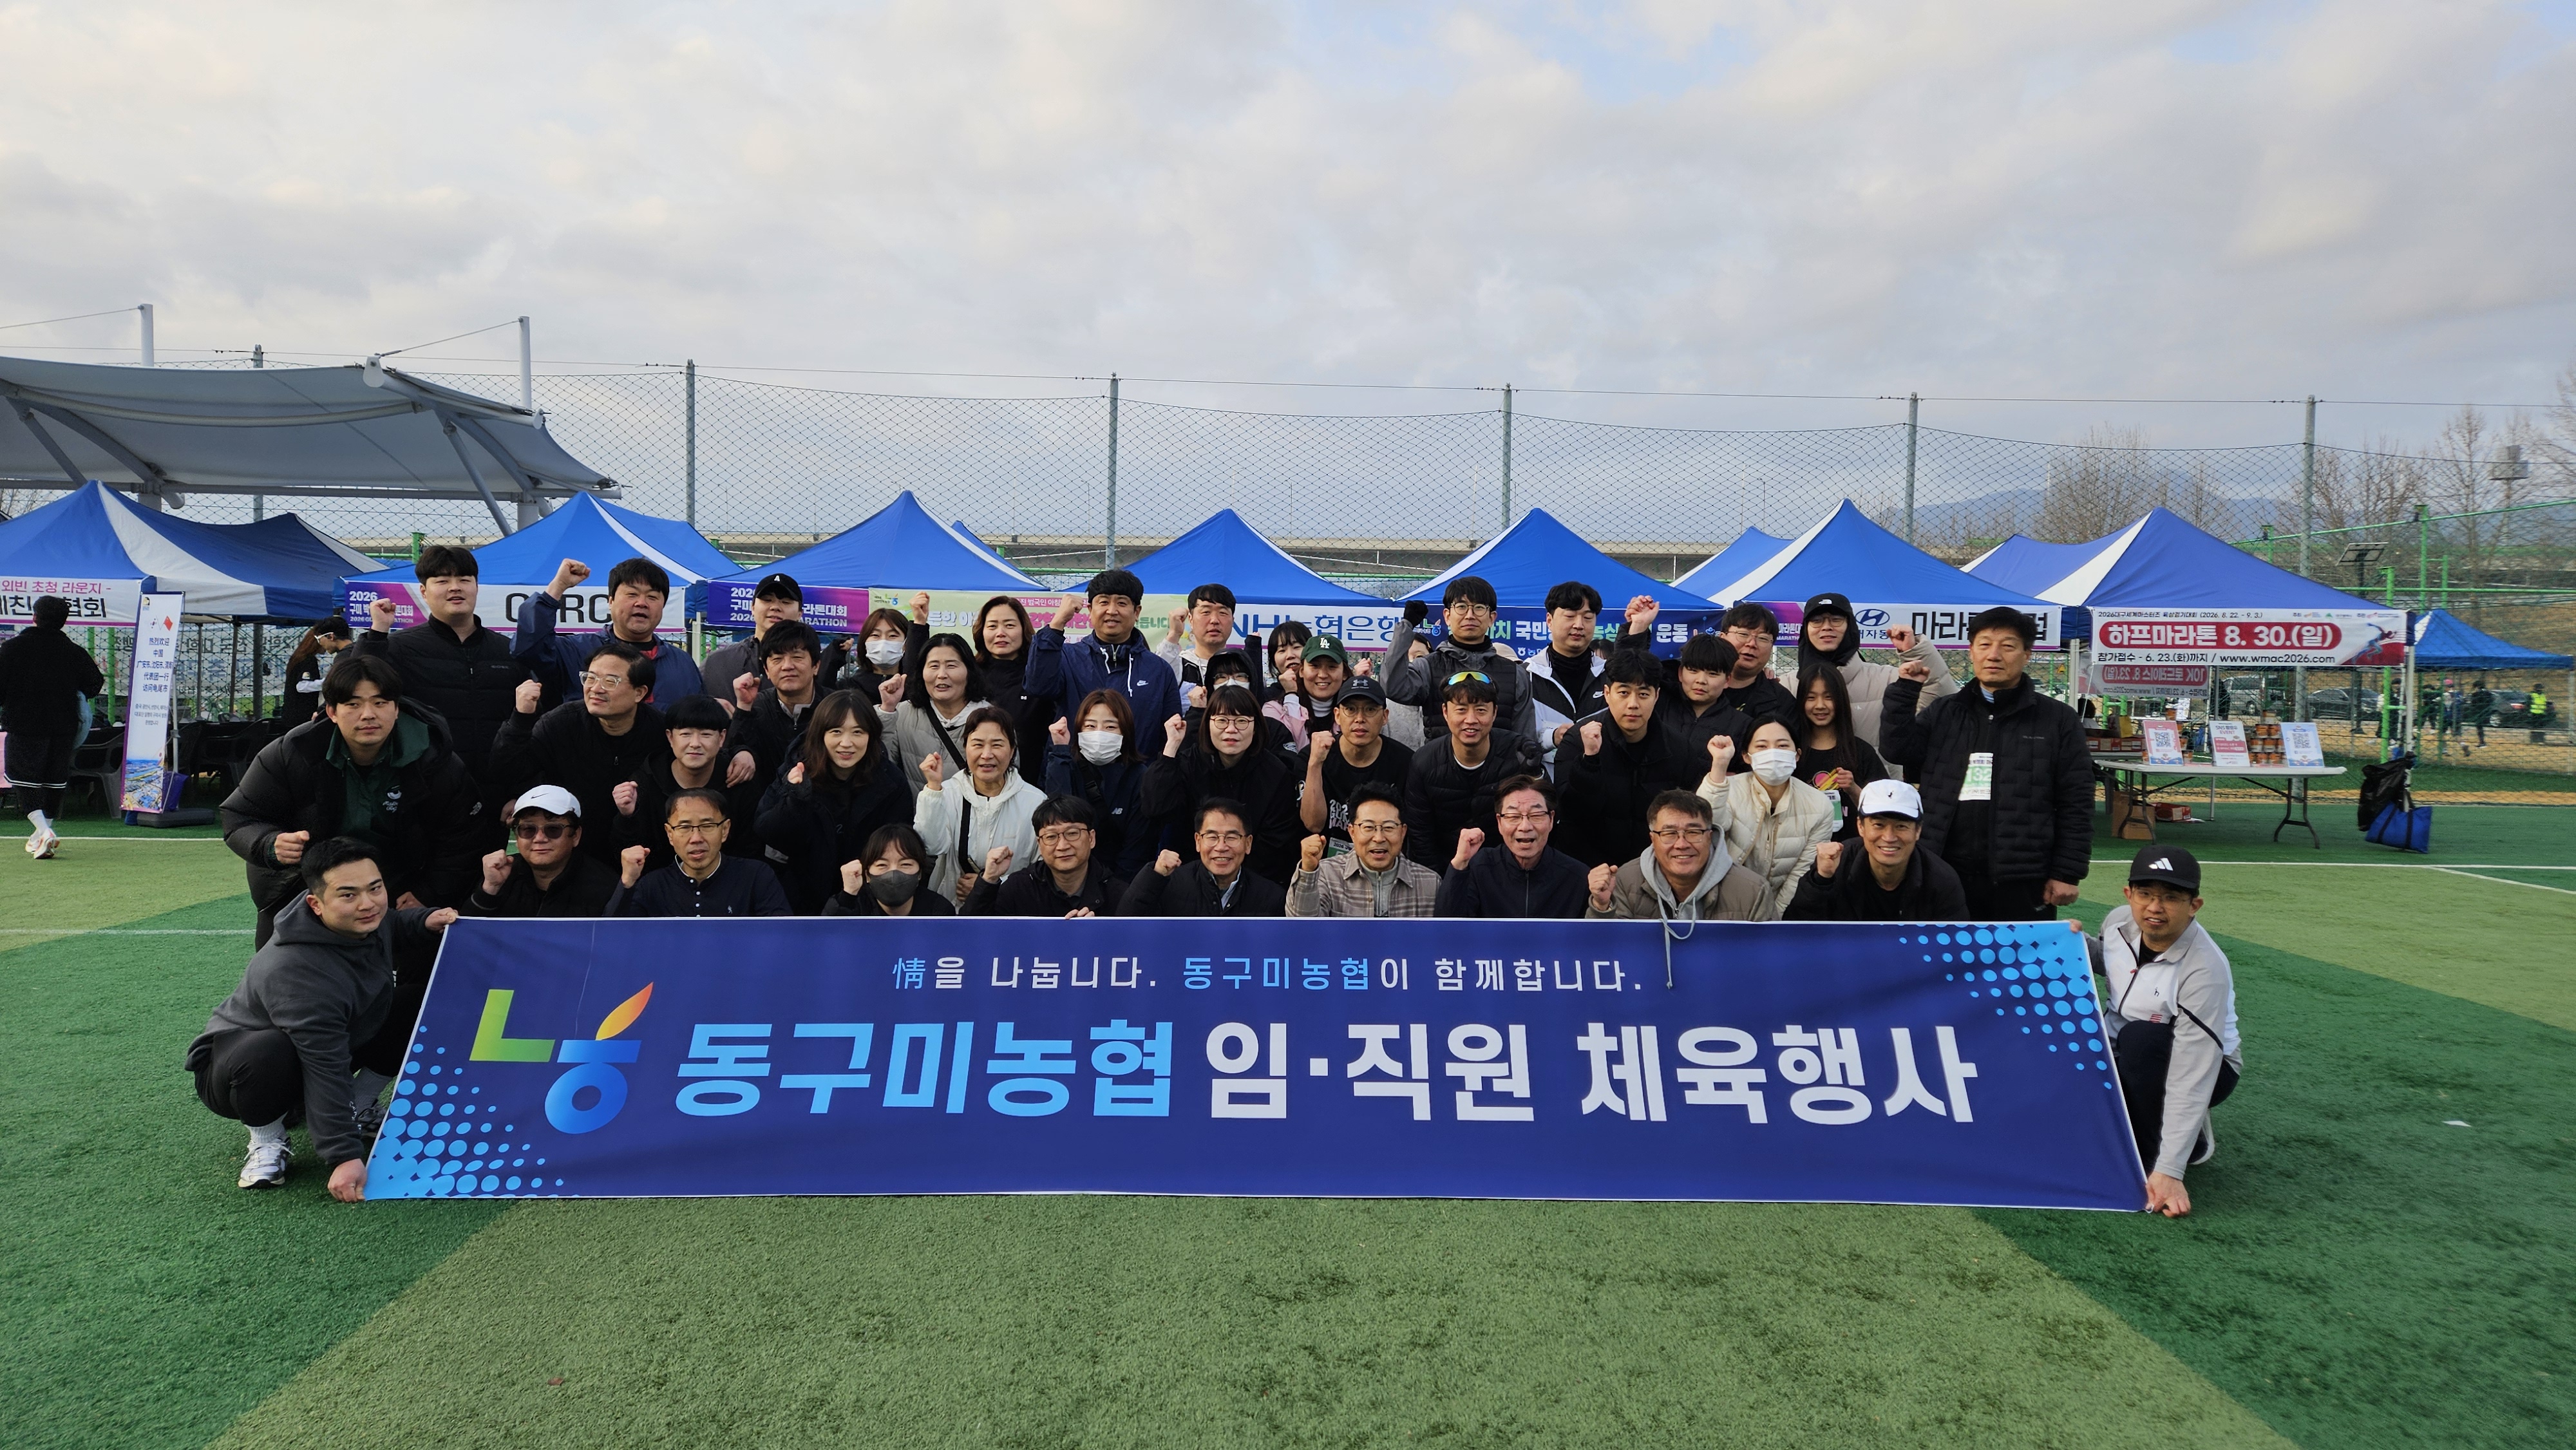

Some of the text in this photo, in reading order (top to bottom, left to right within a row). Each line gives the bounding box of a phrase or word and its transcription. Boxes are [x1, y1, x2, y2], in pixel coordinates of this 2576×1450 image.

[1, 580, 27, 592] 외빈
[32, 581, 57, 593] 초청
[62, 582, 101, 594] 라운지
[349, 591, 378, 601] 2026
[0, 595, 107, 617] 친협회
[350, 603, 362, 615] 구미
[802, 603, 847, 617] 라톤대회
[799, 617, 847, 627] ARATHON
[1135, 616, 1170, 629] 듭니다
[1233, 613, 1405, 643] NH협은행
[1656, 623, 1689, 643] 운동
[2108, 624, 2333, 647] 하프마라톤 8. 30.(일)
[1320, 637, 1330, 648] LA
[153, 648, 164, 657] 中国
[2098, 652, 2136, 662] 참가접수
[2146, 653, 2154, 662] 6.
[2157, 652, 2208, 663] 23.(화)까지
[2220, 654, 2335, 664] www.wmac2026.com
[144, 672, 169, 681] 代表团一行
[893, 957, 1642, 992] 情을 나눕니다. 동구미농협이 함께합니다.
[675, 1019, 1979, 1125] 동구미농협 임·직원 체육행사
